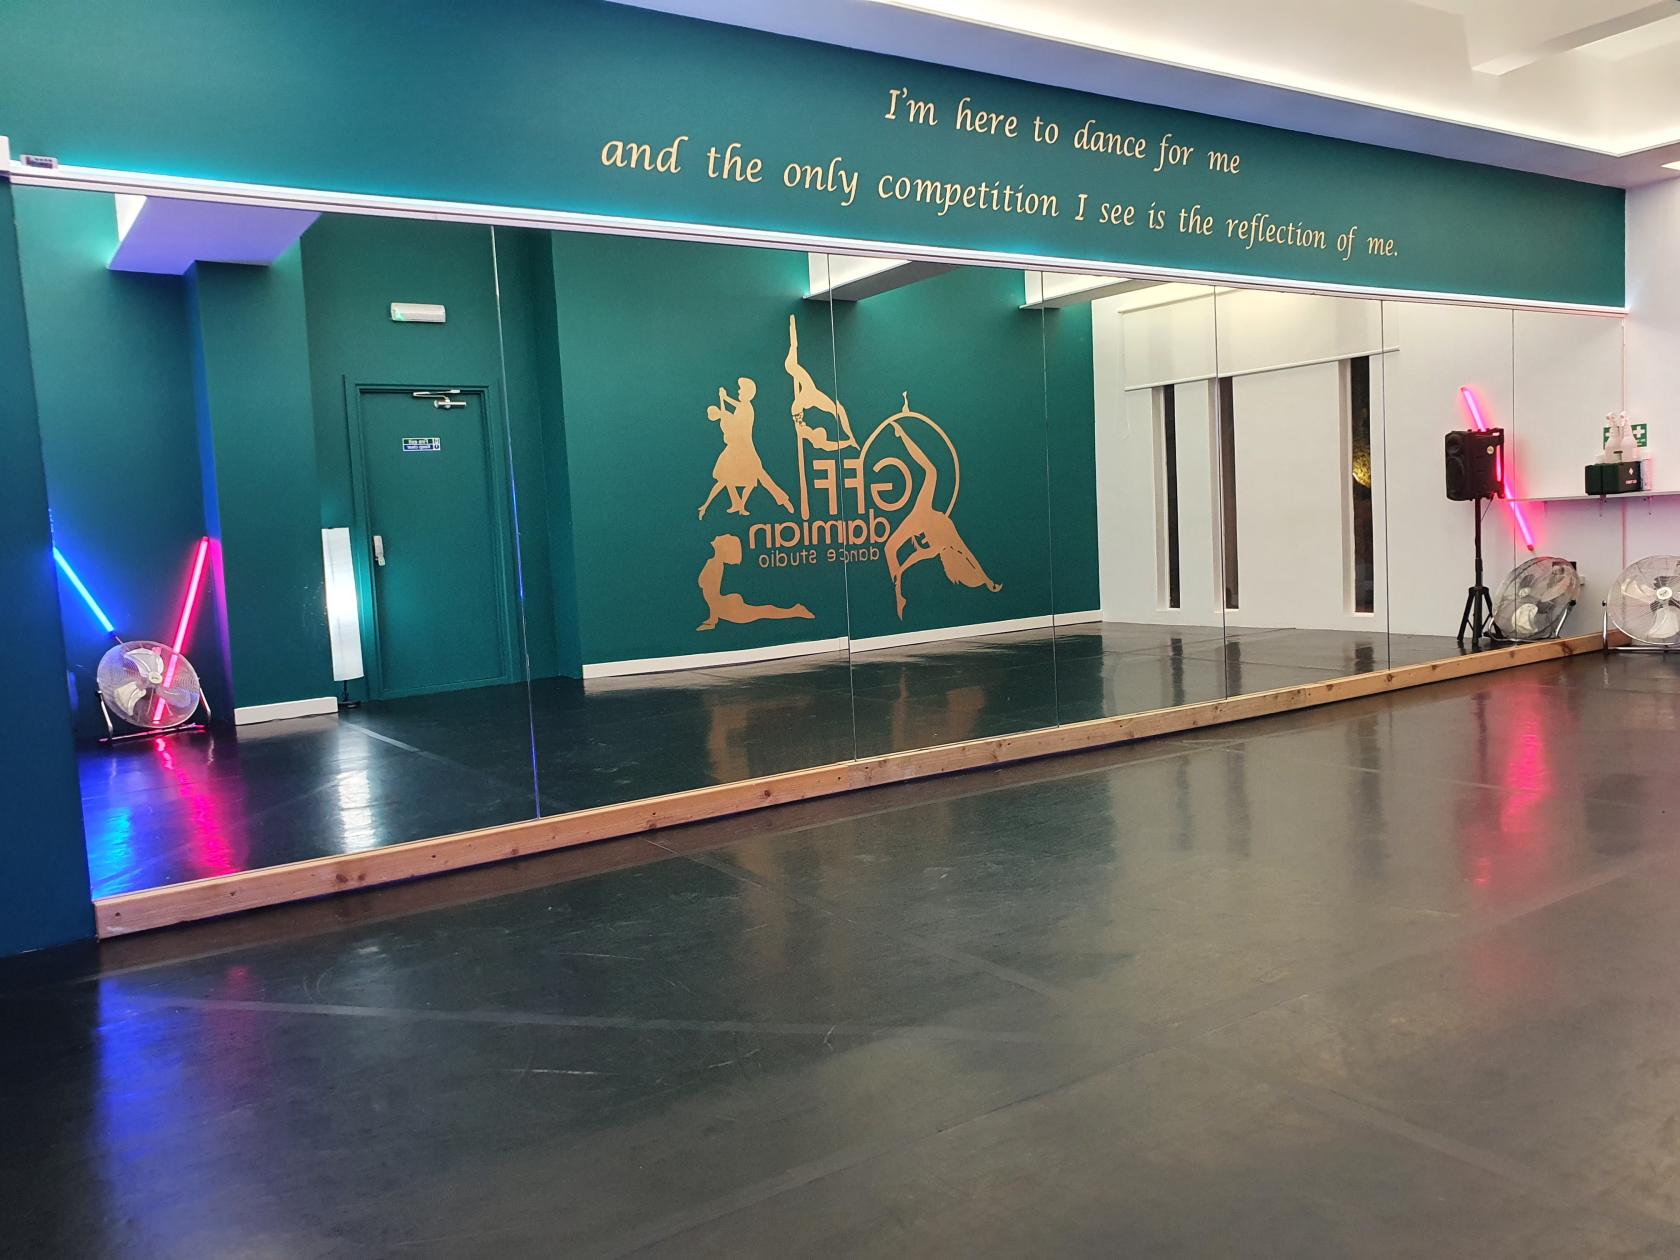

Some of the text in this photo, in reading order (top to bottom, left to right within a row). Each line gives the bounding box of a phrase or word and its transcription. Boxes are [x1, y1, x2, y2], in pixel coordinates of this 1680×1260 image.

[884, 87, 1240, 174] I'm here to dance for me
[601, 135, 1398, 261] and the only competition I see is the reflection of me.
